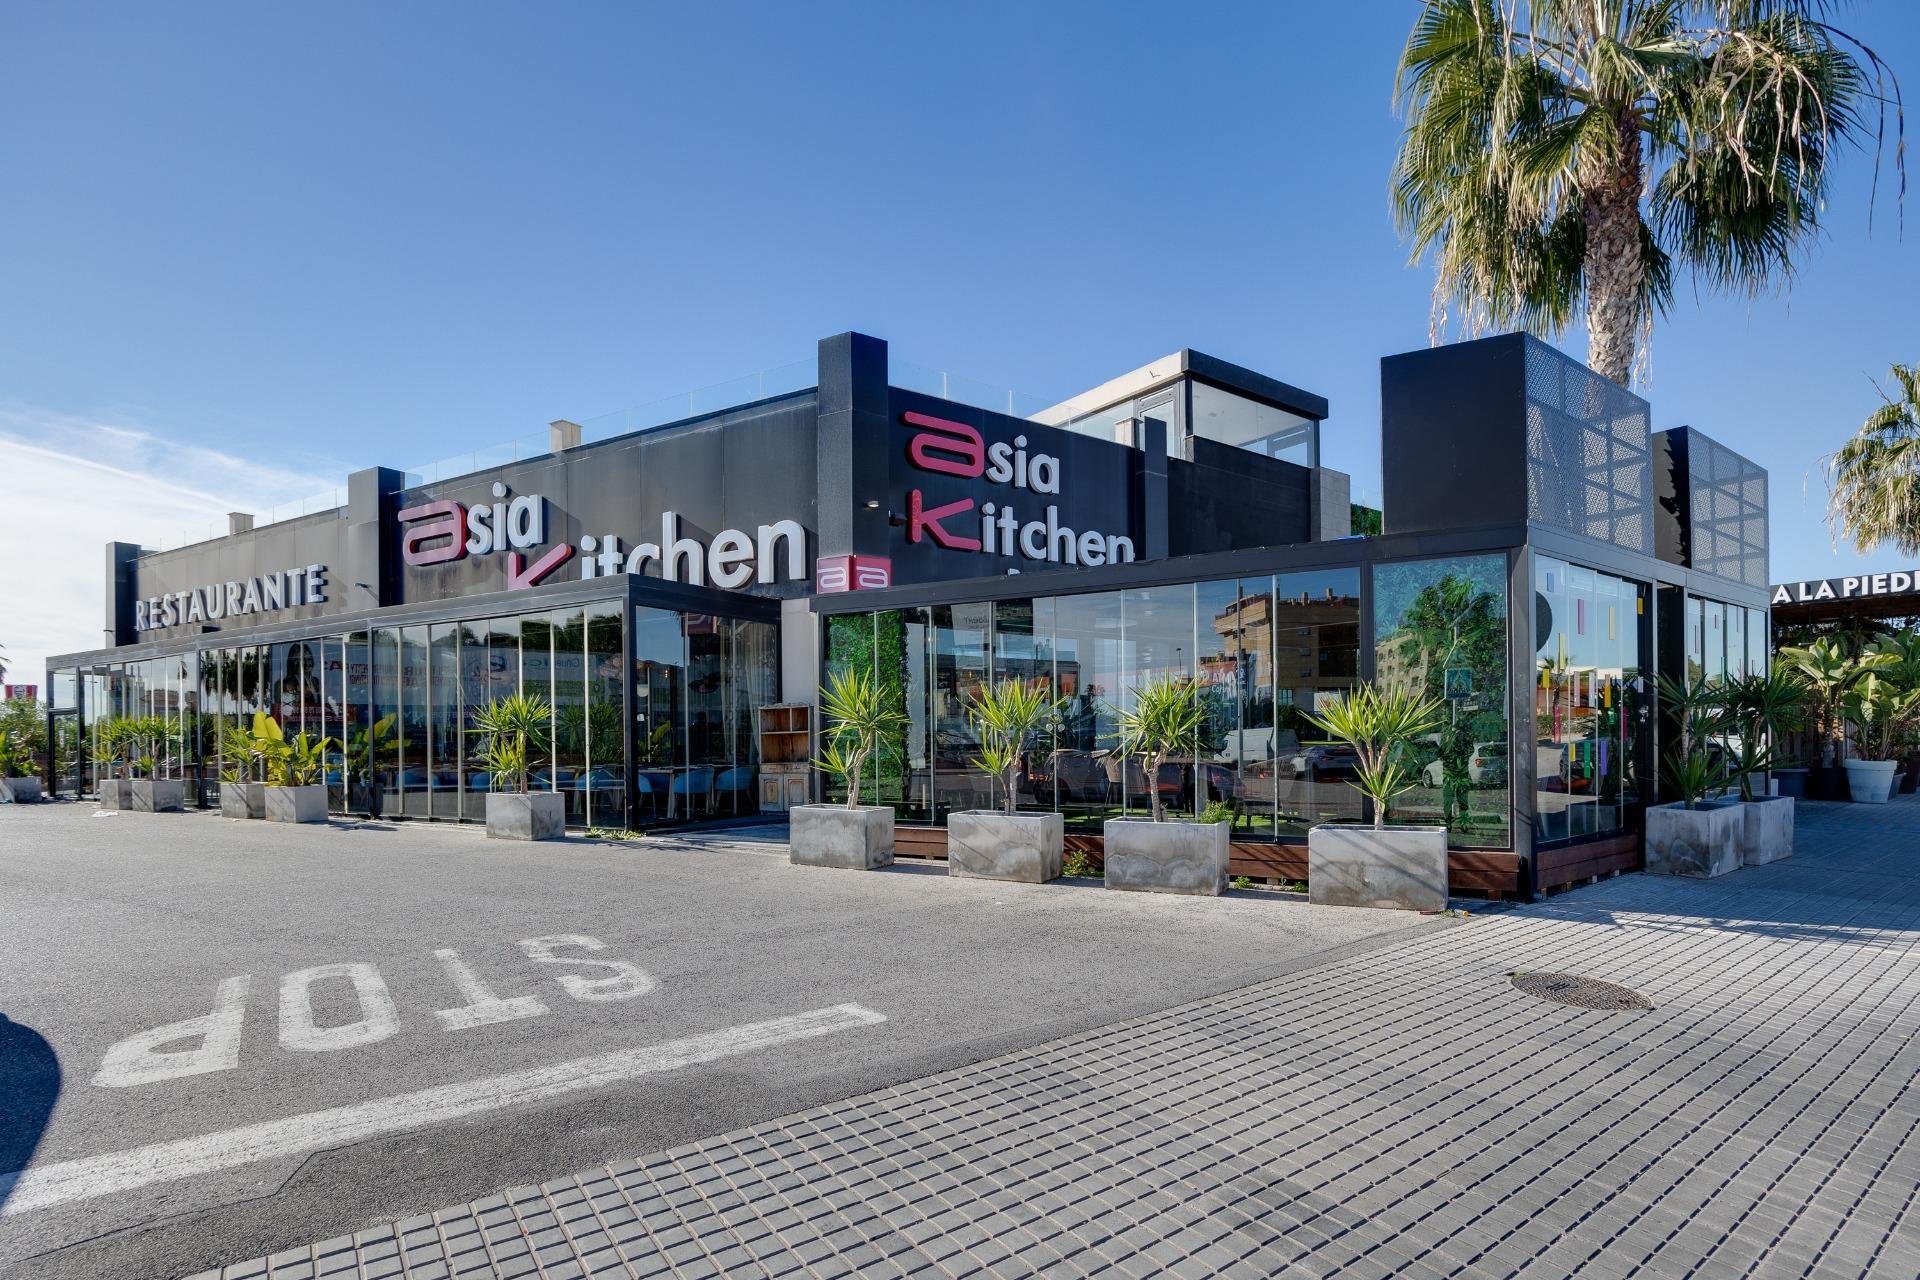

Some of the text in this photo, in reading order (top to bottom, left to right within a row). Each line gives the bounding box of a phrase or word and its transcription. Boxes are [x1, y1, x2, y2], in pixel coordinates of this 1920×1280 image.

[905, 488, 1135, 567] Kitchen
[136, 563, 327, 631] RESTAURANTE
[1771, 584, 1793, 604] A
[1799, 580, 1837, 601] LA
[91, 933, 661, 1088] STOP
